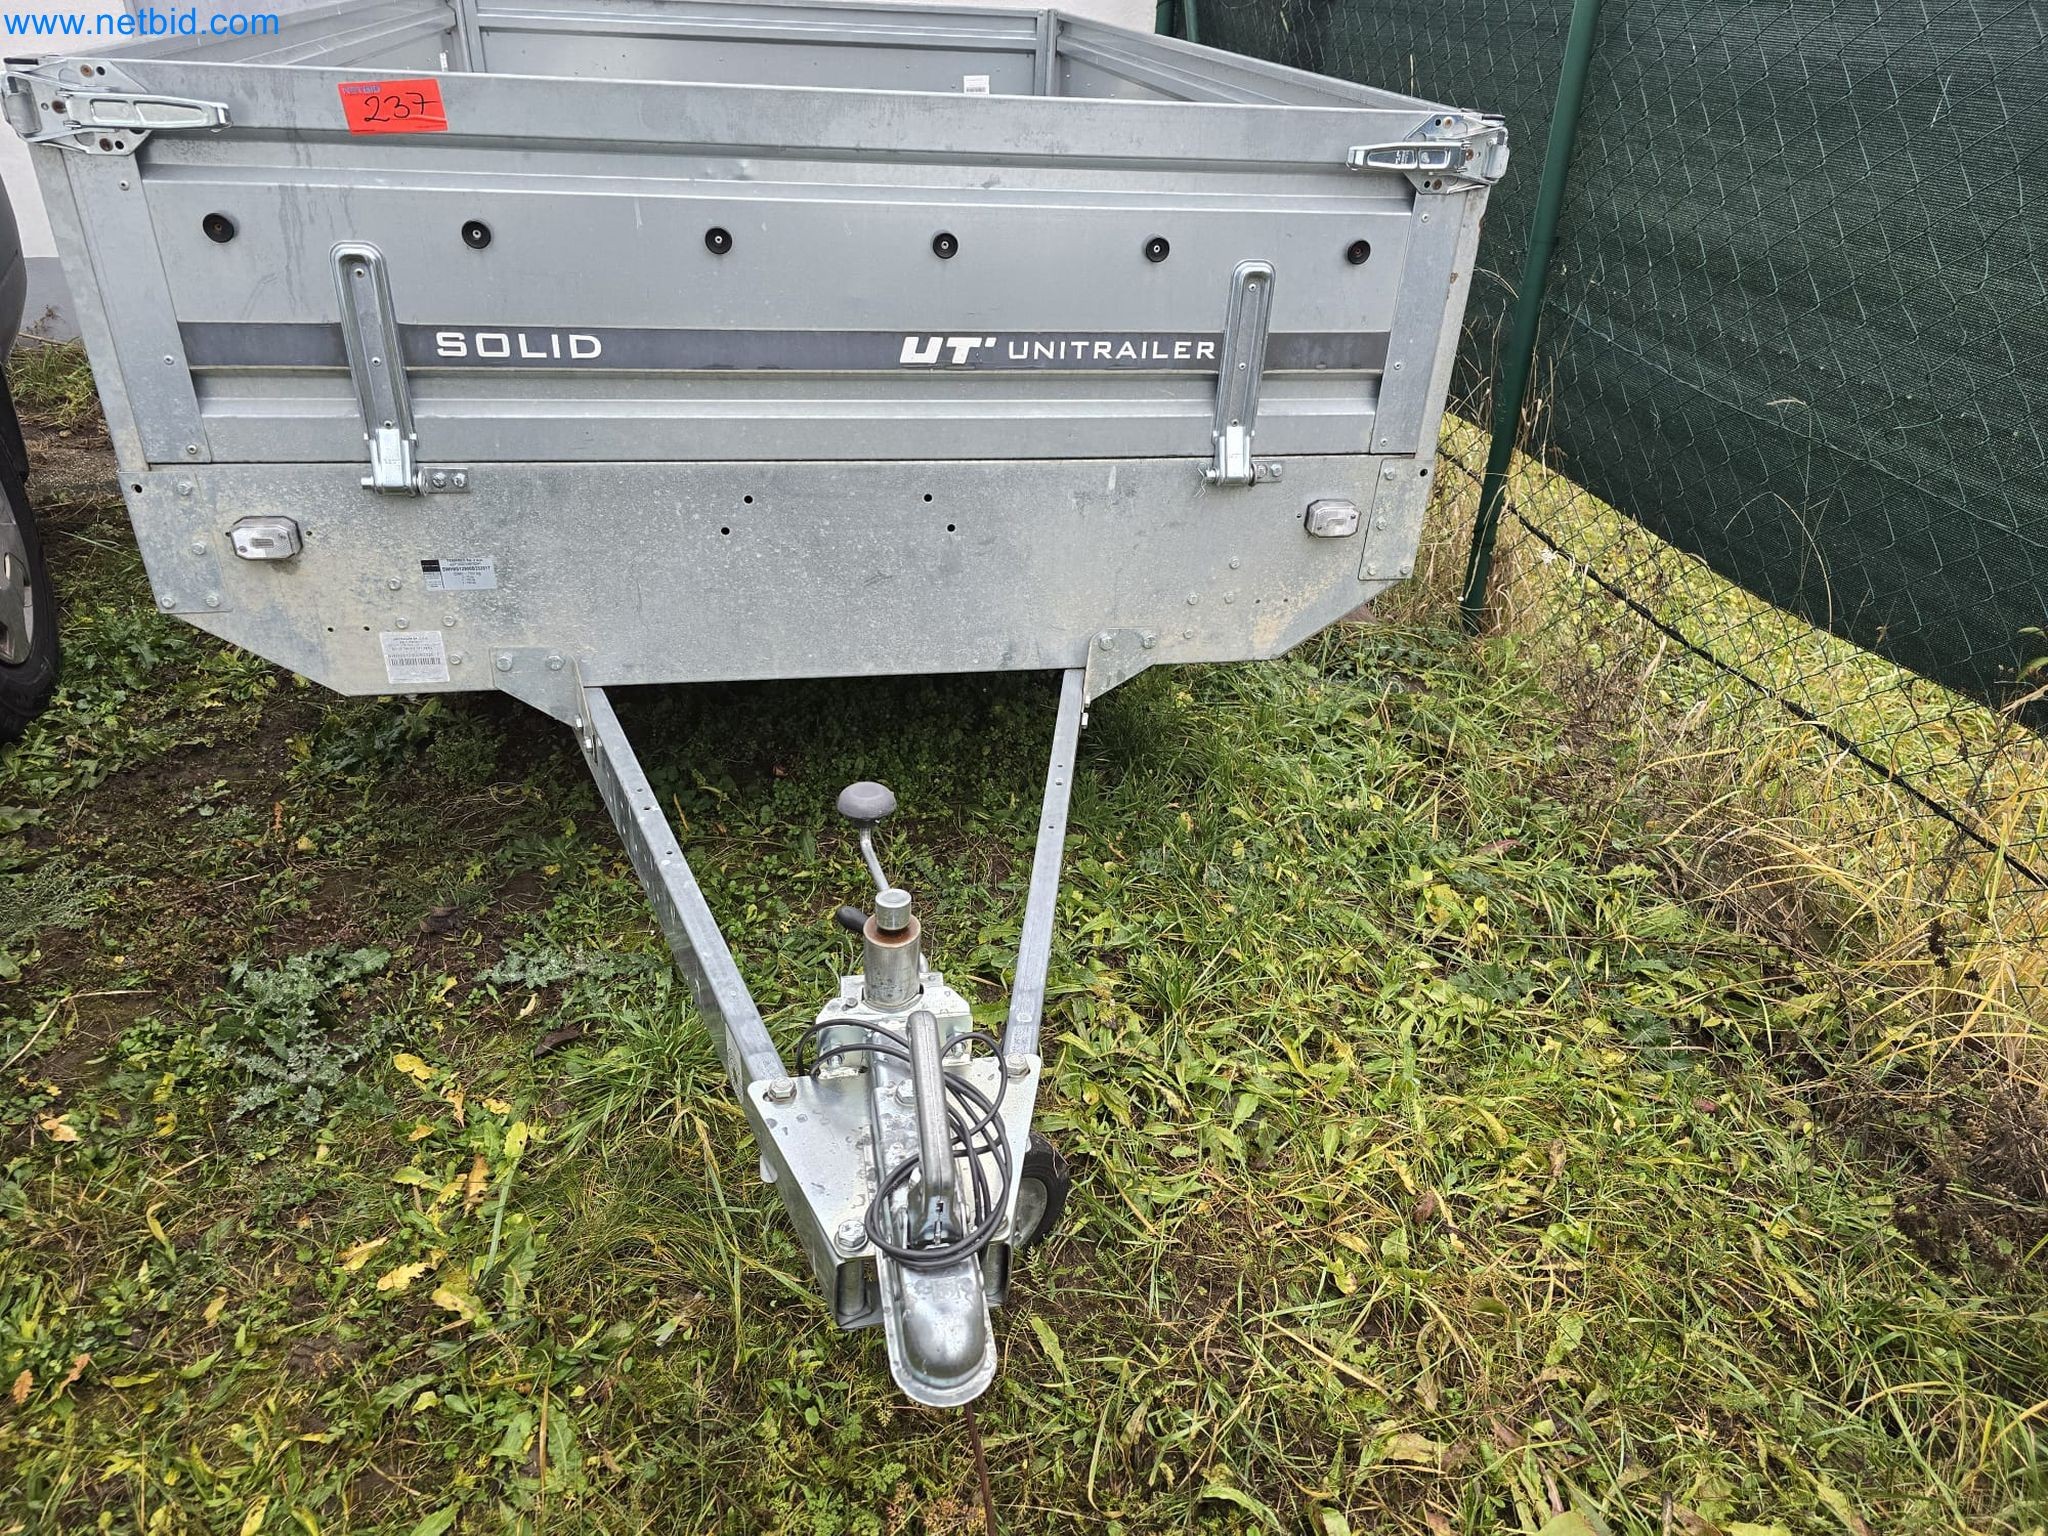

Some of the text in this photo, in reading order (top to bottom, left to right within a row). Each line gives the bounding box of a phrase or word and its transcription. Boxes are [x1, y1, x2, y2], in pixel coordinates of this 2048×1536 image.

[364, 92, 438, 122] 237
[436, 332, 602, 359] SOLID
[1008, 341, 1216, 360] UNITRAILER
